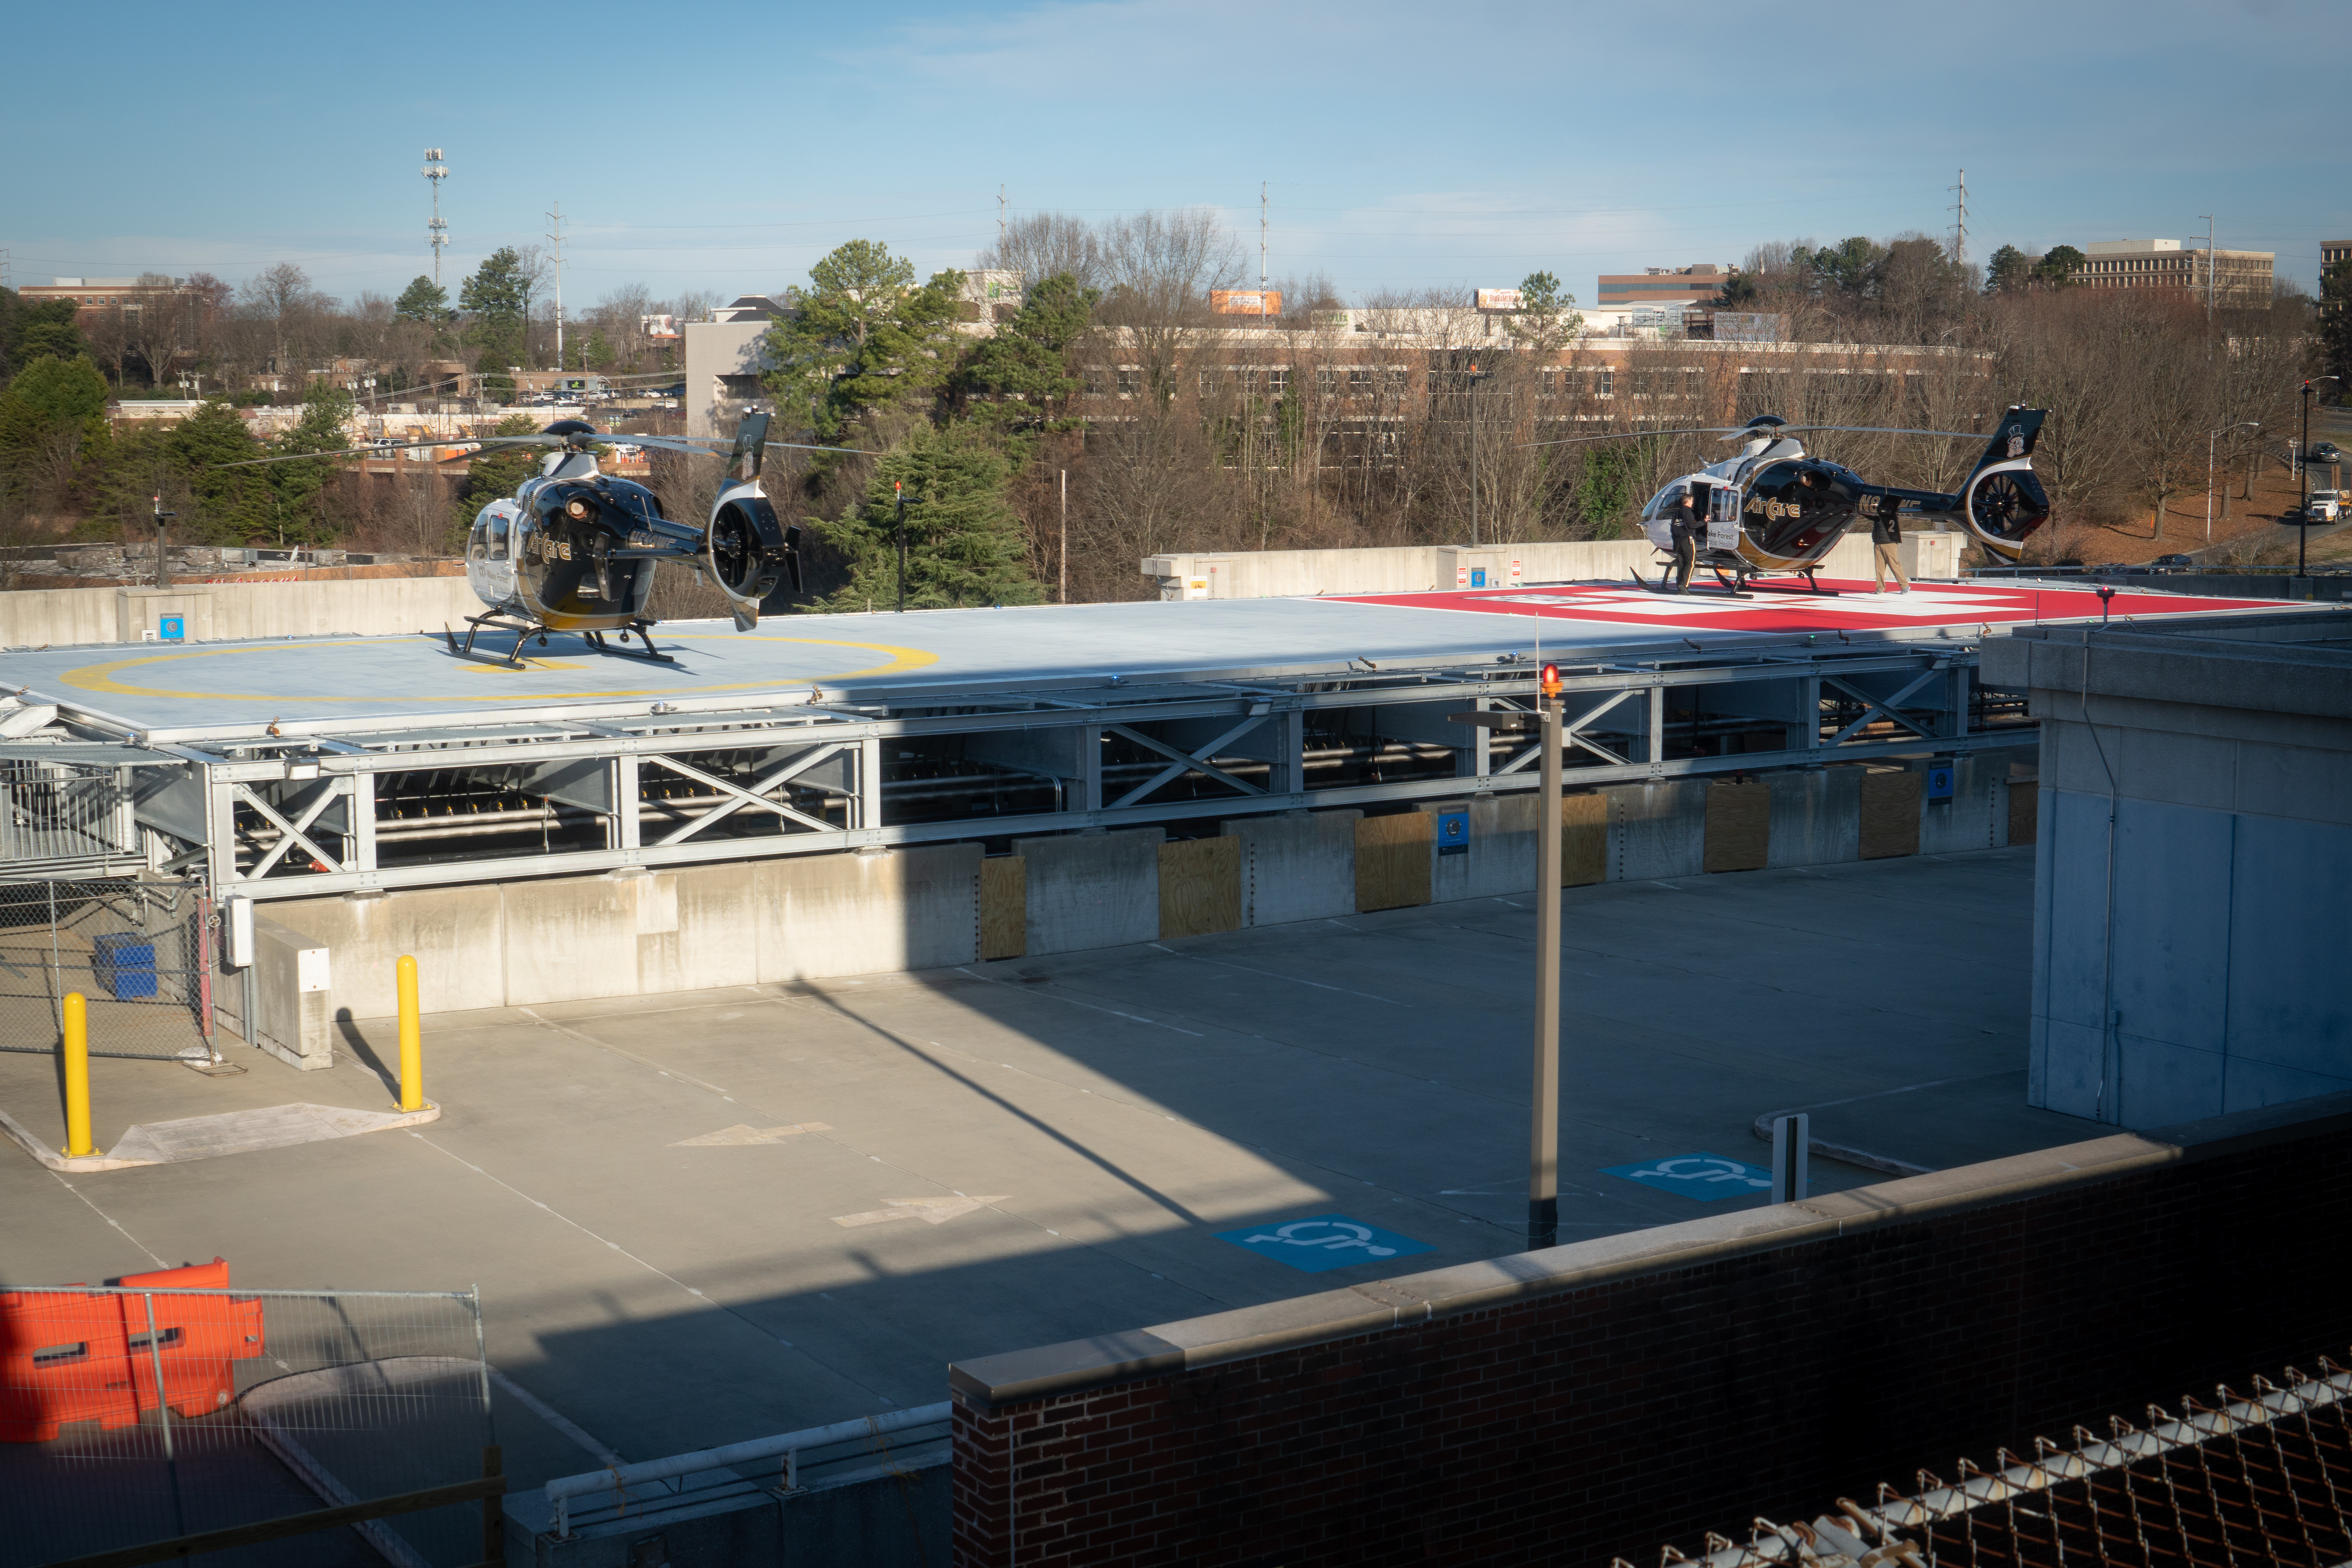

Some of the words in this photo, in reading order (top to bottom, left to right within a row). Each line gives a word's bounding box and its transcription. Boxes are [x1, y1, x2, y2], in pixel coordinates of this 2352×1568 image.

[1744, 495, 1800, 521] AirCare
[1888, 519, 1895, 532] 2
[1718, 531, 1734, 540] Forest
[526, 532, 571, 564] AirCare
[497, 572, 509, 584] Forest
[169, 622, 175, 631] C
[1937, 775, 1943, 786] C
[1449, 821, 1456, 834] C
